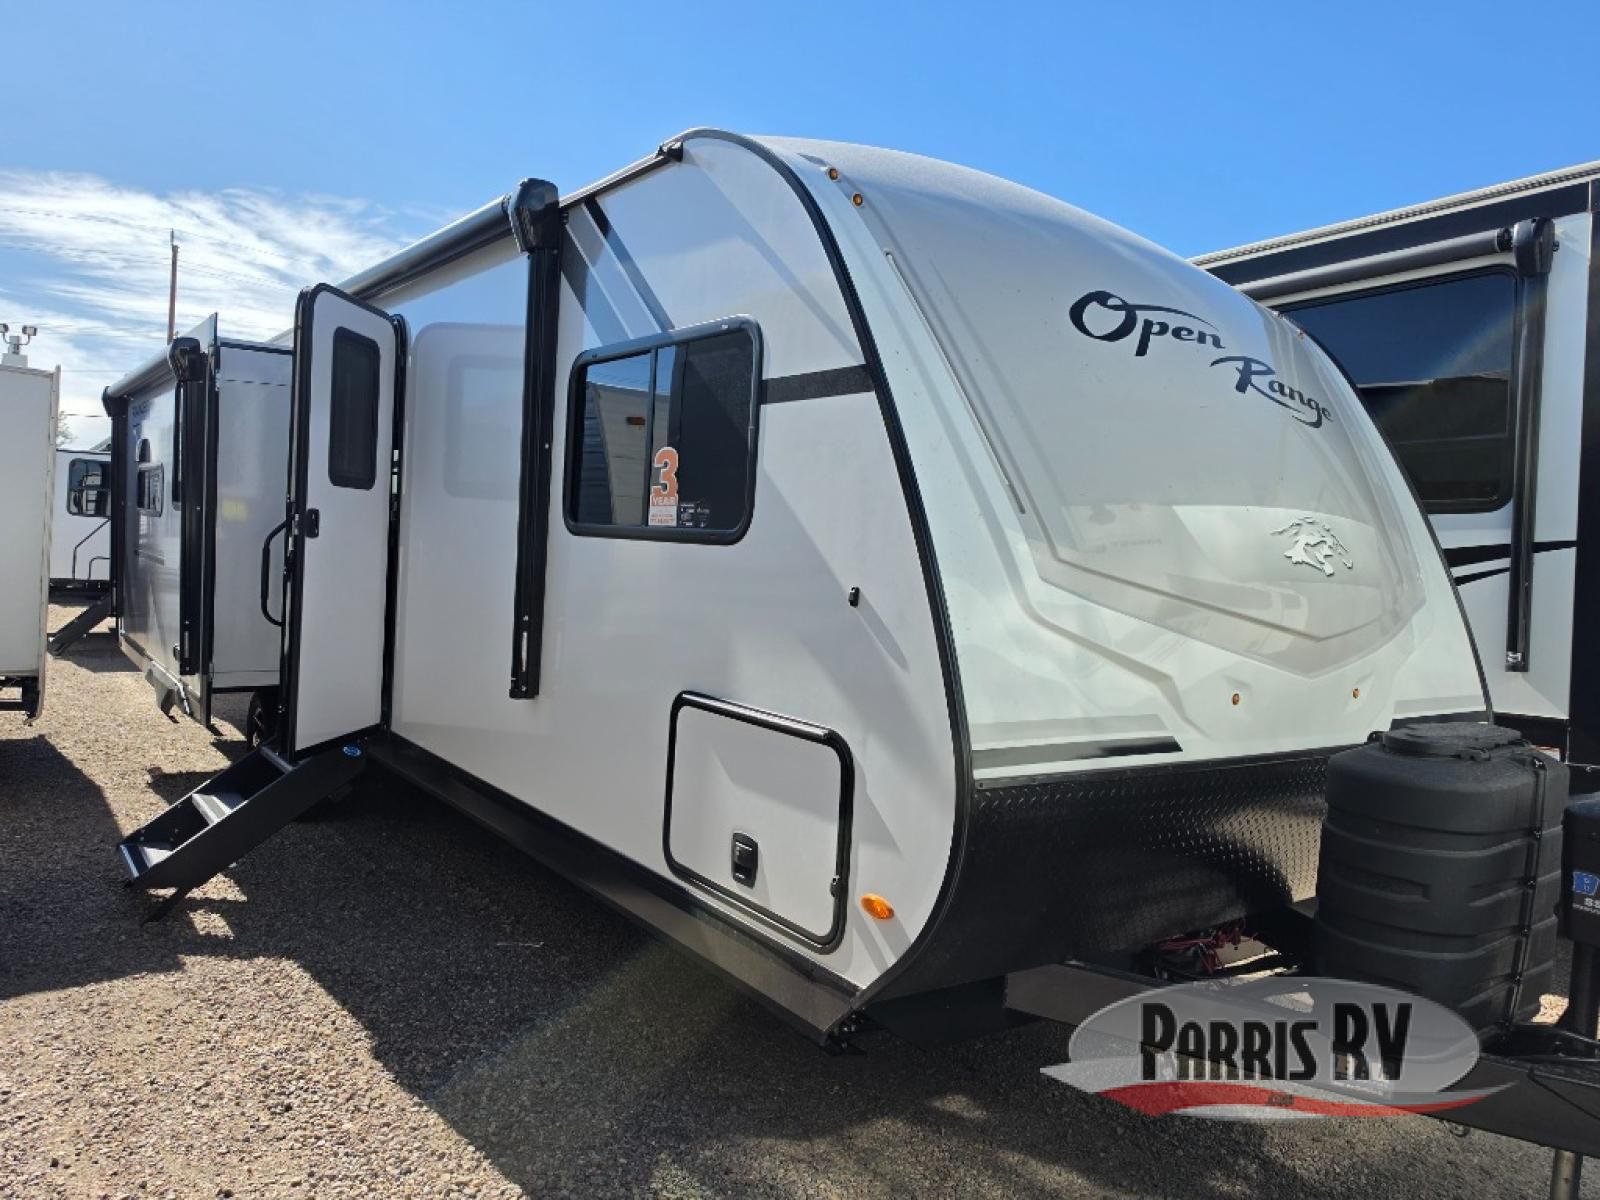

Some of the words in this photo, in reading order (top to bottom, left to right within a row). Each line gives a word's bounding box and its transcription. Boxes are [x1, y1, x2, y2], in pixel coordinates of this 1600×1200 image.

[1069, 290, 1225, 356] Open
[1210, 355, 1334, 428] Range
[652, 447, 679, 497] 3
